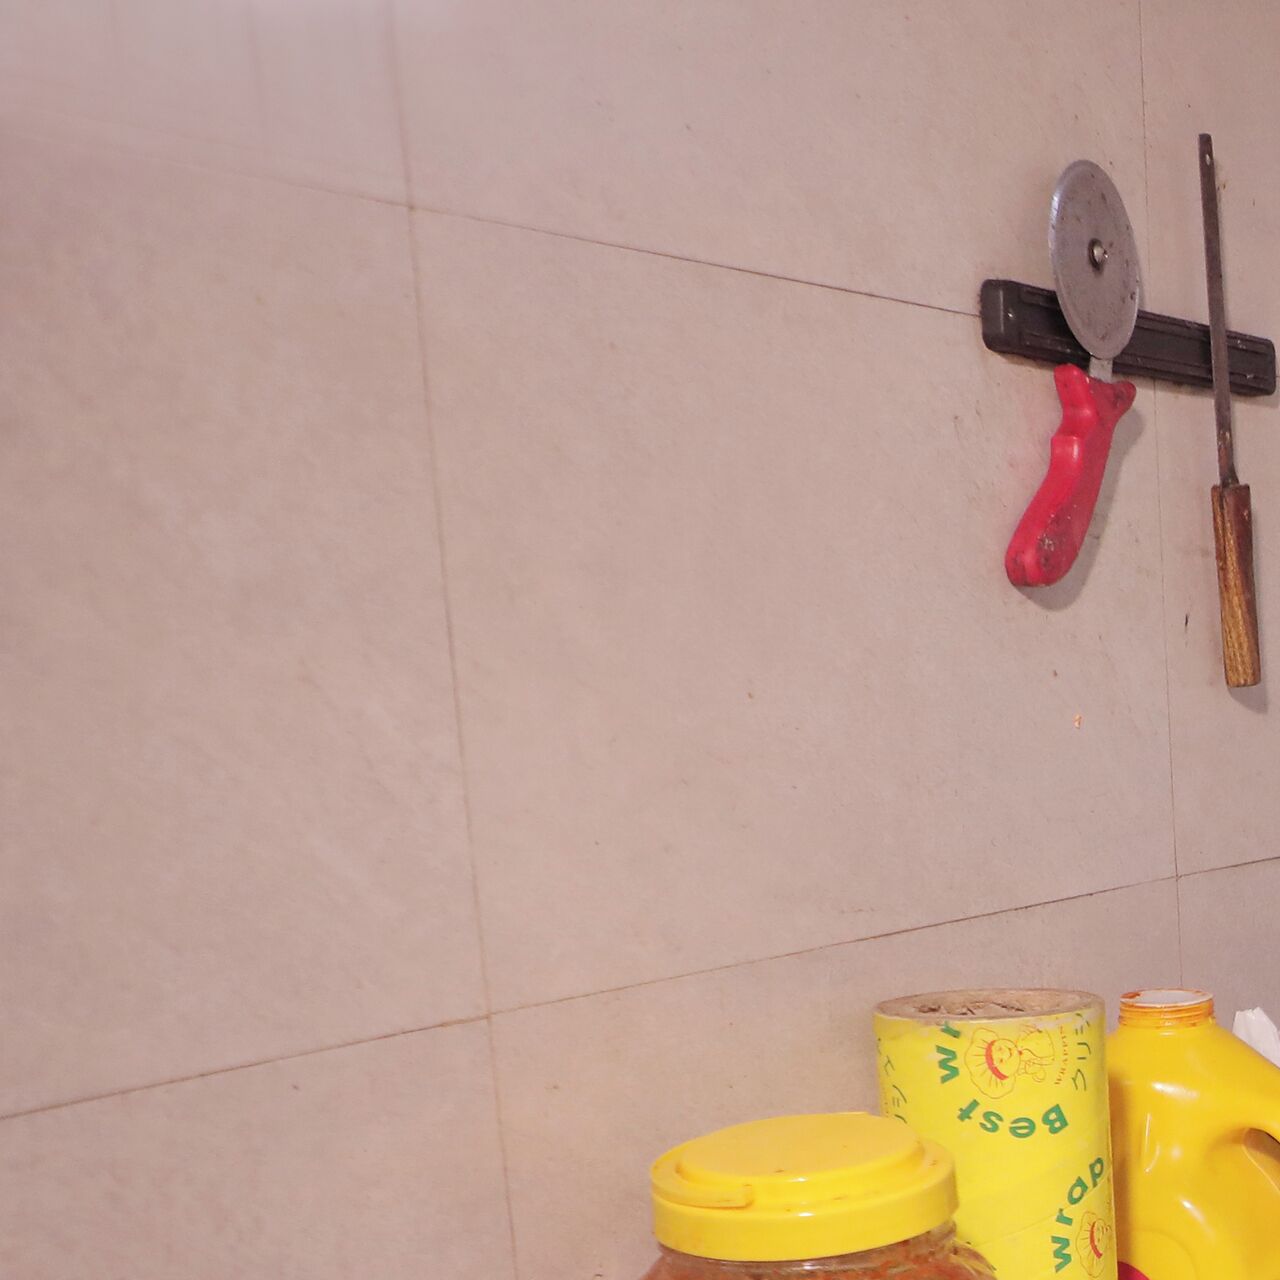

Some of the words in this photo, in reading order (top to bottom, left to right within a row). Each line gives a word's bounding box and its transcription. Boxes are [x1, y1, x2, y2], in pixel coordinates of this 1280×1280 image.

[935, 1021, 961, 1084] wr
[957, 1099, 1069, 1139] Best
[1051, 1157, 1105, 1273] wrap
